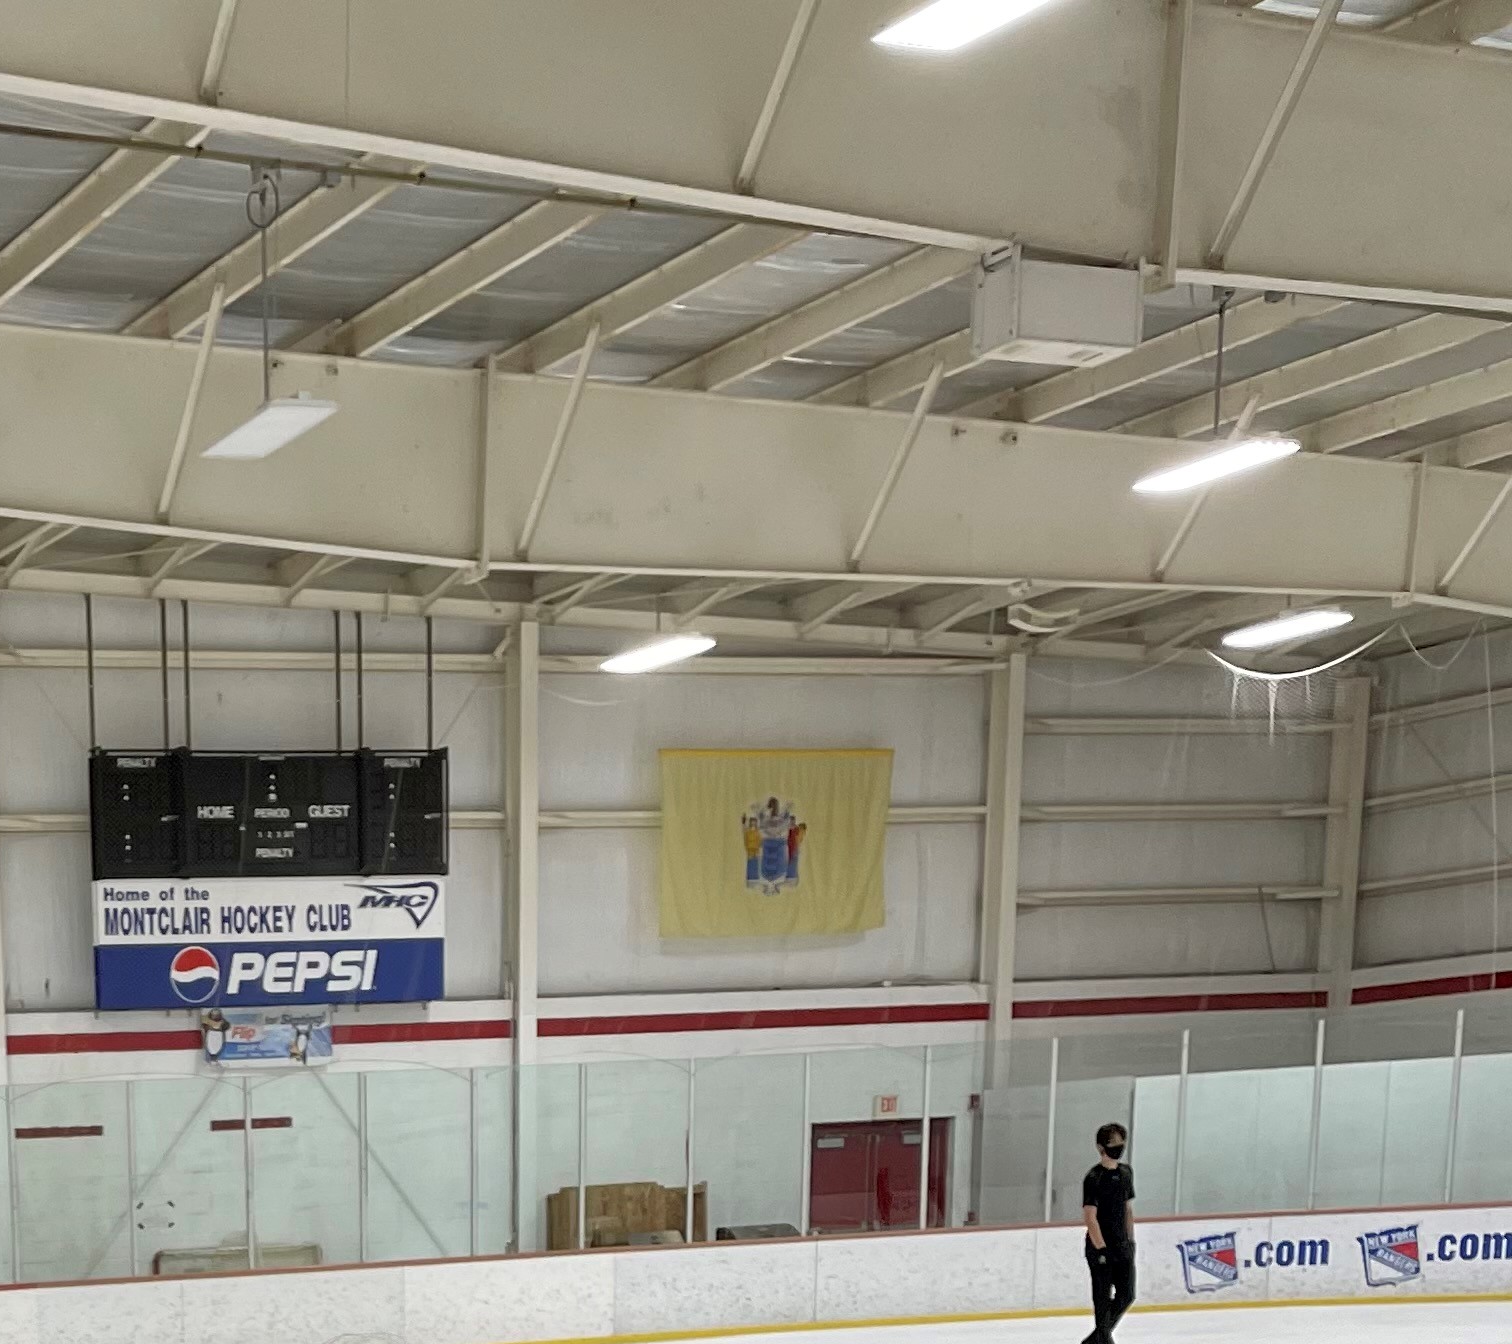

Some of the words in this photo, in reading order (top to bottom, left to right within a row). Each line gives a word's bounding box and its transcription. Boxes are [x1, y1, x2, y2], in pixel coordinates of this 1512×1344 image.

[197, 806, 235, 818] HOME
[254, 808, 290, 818] PERIOD
[308, 804, 351, 818] GUEST
[103, 887, 150, 901] Home
[159, 887, 175, 901] of
[184, 886, 210, 901] the
[104, 907, 211, 936] MONTCLAIR
[221, 904, 296, 935] HOCKEY
[306, 903, 352, 932] CLUB
[226, 949, 379, 995] PEPSI
[1244, 1238, 1330, 1268] .com
[1426, 1232, 1512, 1262] .com
